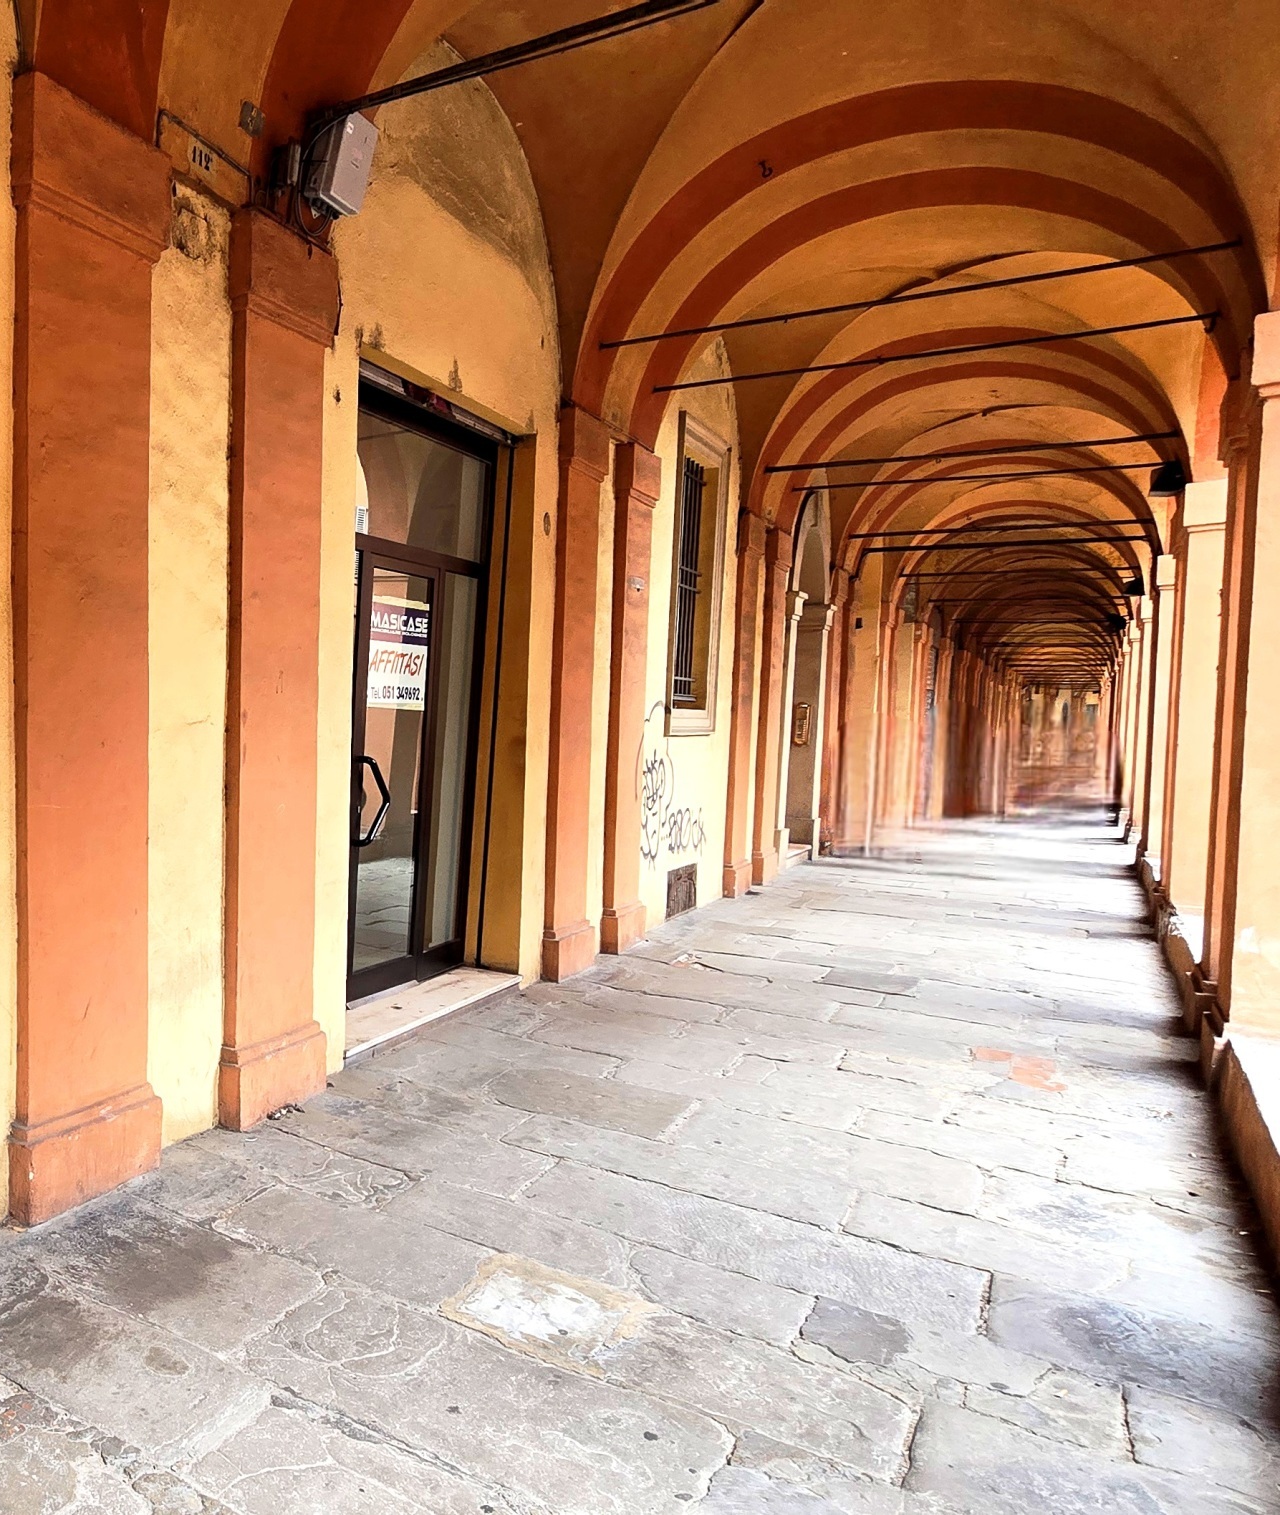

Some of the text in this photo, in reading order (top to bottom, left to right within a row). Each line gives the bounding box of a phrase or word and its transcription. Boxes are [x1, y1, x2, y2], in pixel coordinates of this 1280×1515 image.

[370, 610, 429, 633] MASICASE
[369, 649, 425, 676] AFFITTASI
[382, 685, 395, 699] 051
[396, 686, 420, 701] 349692
